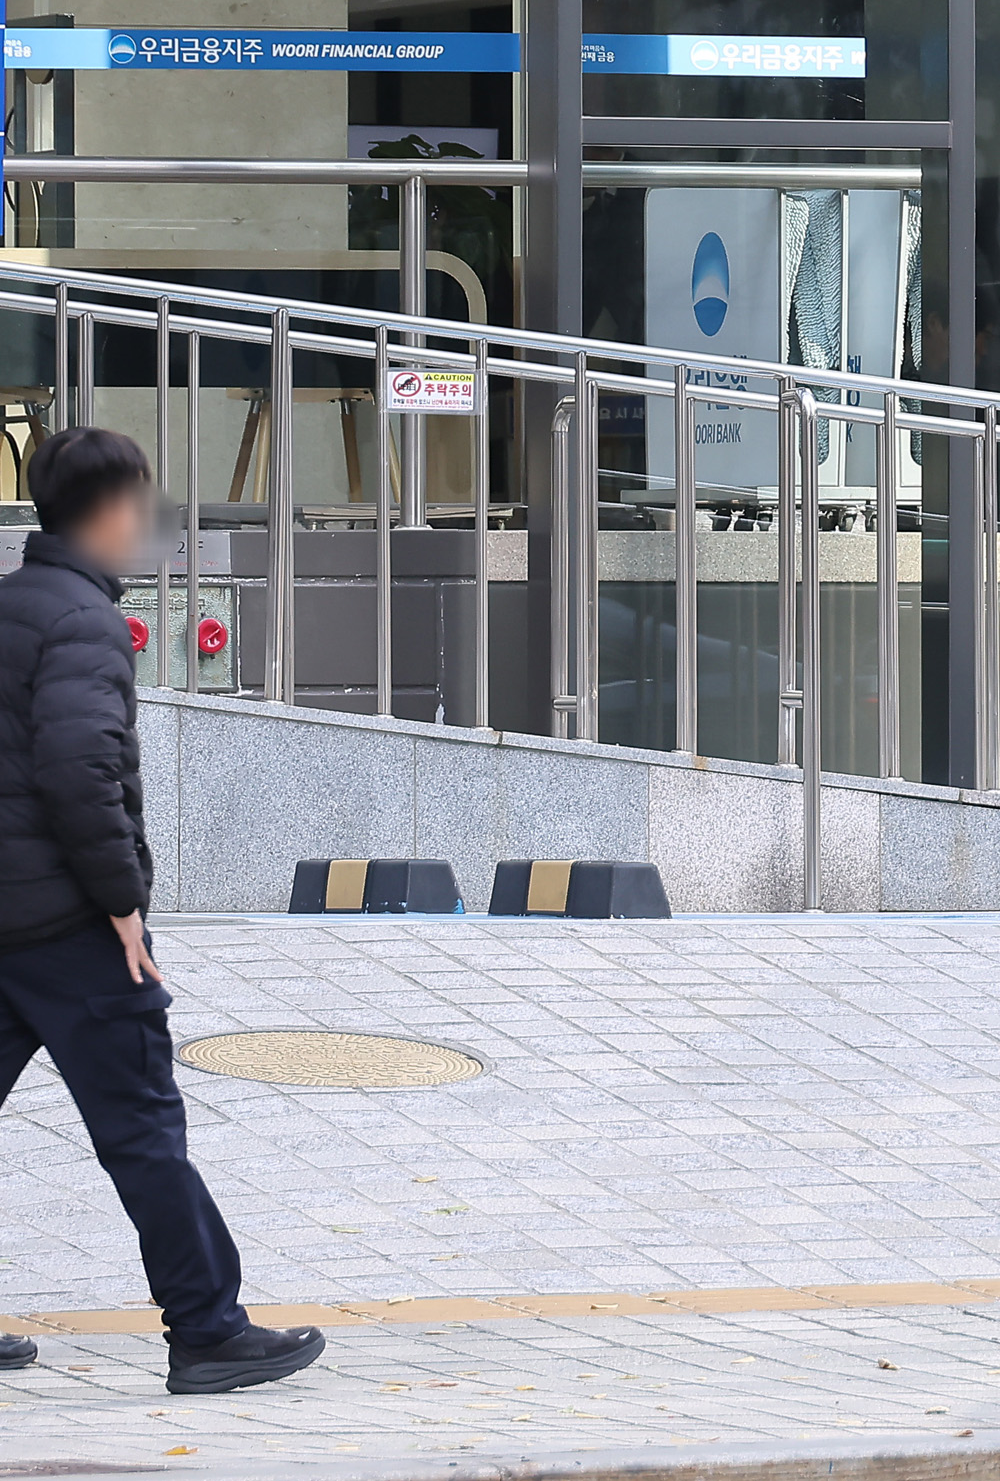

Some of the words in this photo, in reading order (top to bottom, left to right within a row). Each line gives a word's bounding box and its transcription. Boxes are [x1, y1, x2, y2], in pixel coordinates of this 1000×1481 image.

[138, 37, 264, 64] 우리금융지주
[271, 43, 319, 58] WOORI
[321, 44, 395, 58] FINANCIAL
[396, 45, 444, 59] GROUP
[720, 43, 844, 71] 우리금융지주
[433, 374, 472, 382] CAUTION
[424, 383, 472, 397] 추락주의
[695, 423, 716, 445] OORI
[717, 423, 742, 444] BANK
